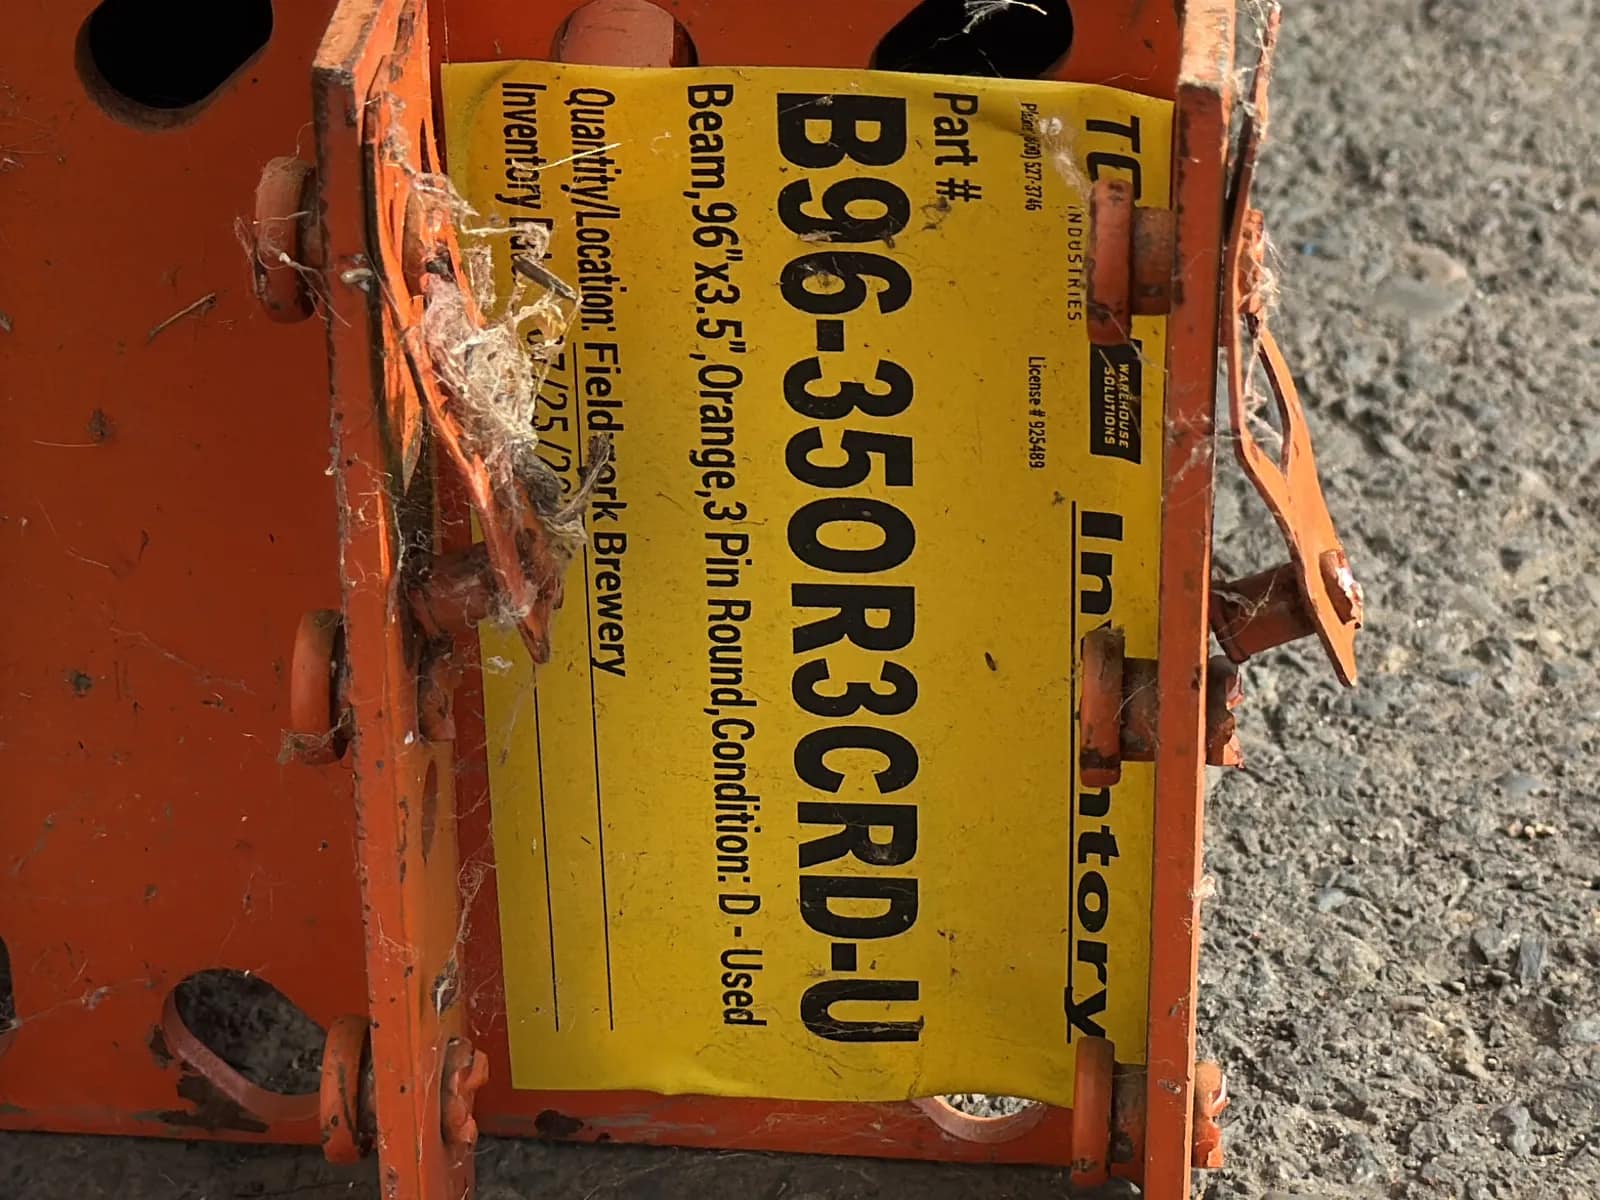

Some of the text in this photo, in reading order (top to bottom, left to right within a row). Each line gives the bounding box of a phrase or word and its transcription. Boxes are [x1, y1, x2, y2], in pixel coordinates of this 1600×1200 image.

[495, 83, 548, 210] Inventory
[933, 92, 982, 202] Part #
[1024, 162, 1043, 211] 527-3746
[560, 88, 627, 332] Quantity/Location:
[1068, 205, 1082, 322] INDUSTRIES
[1028, 356, 1046, 469] License # 925489
[1104, 366, 1116, 445] SOLUTIONS
[1118, 363, 1129, 449] WAREHOUSE
[591, 532, 627, 677] Brewery
[704, 533, 753, 587] Pin
[702, 599, 762, 883] Round,Condition:
[1064, 510, 1123, 1040] Inntory
[718, 893, 761, 915] D
[720, 949, 767, 1026] Used
